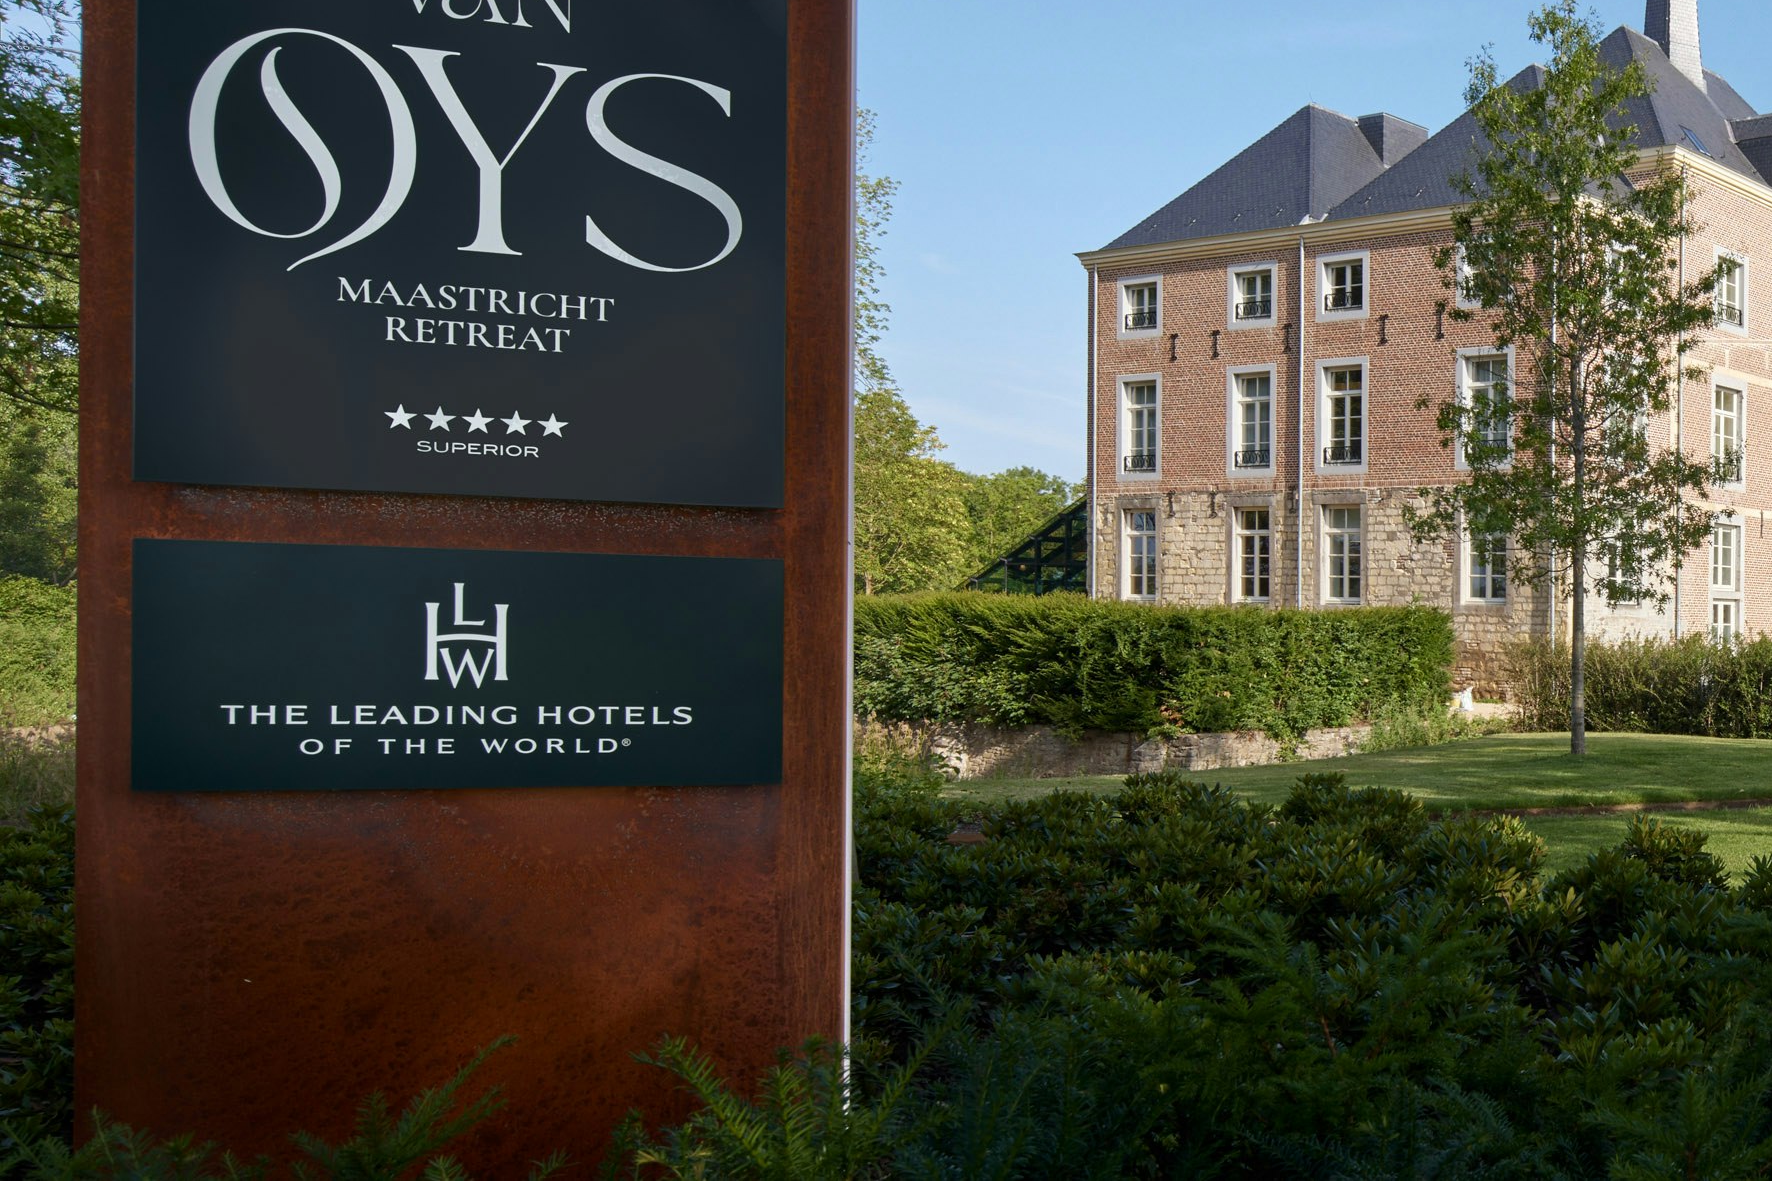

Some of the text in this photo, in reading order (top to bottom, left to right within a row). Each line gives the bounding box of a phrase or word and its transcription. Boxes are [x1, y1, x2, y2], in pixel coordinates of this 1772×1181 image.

[188, 27, 743, 273] OYS
[336, 276, 615, 322] MAASTRICHT
[384, 316, 571, 353] RETREAT
[416, 440, 540, 459] SUPERIOR
[220, 704, 693, 725] THE LEADING HOTELS
[299, 738, 353, 756] OF
[377, 738, 455, 755] THE
